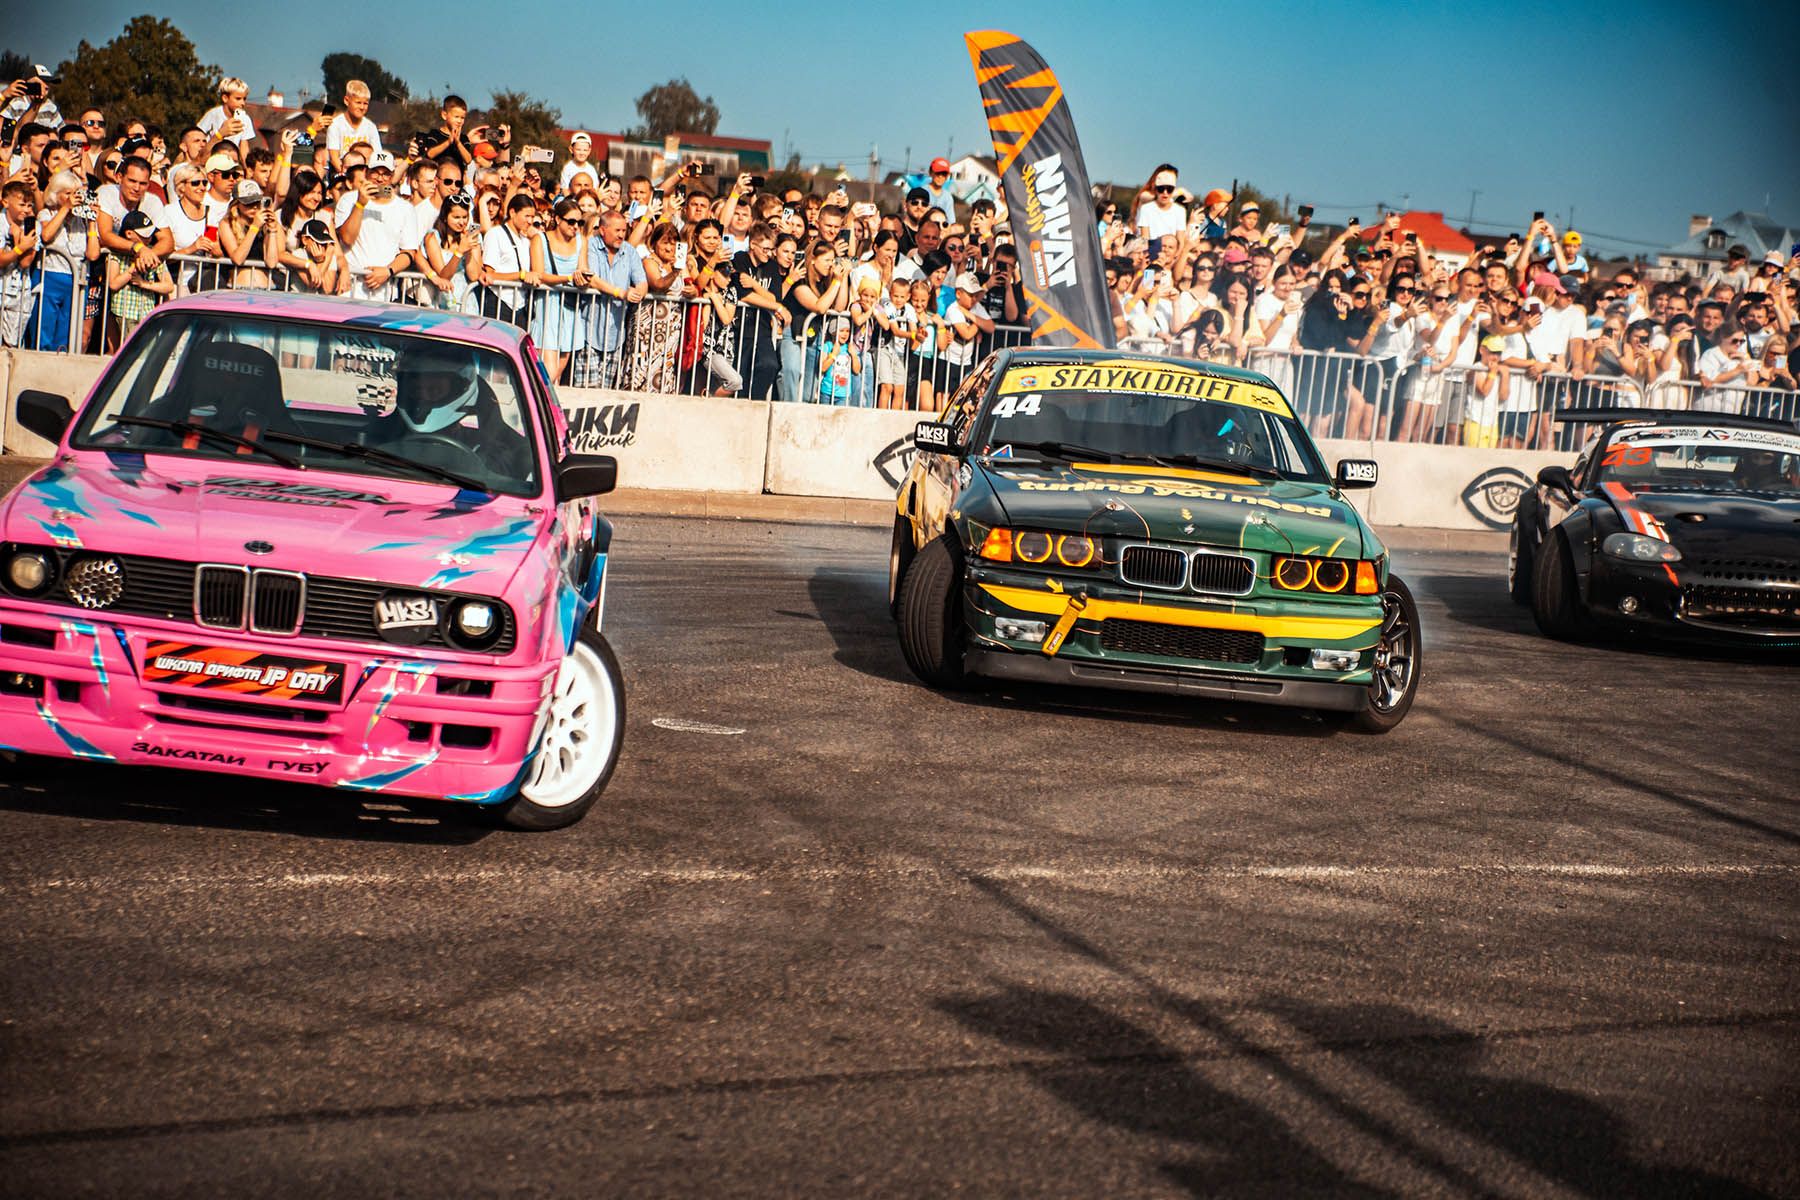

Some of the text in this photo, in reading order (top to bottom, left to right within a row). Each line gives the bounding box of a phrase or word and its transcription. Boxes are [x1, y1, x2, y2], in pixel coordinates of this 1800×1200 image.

[204, 356, 264, 378] BRIDE
[991, 394, 1042, 418] 44
[575, 431, 636, 453] Niknik
[1601, 447, 1652, 468] 43
[1018, 480, 1332, 518] tuning you need
[155, 656, 335, 692] ШКОЛА ДРИФТА JP DAY
[267, 759, 331, 774] ГУБУ
